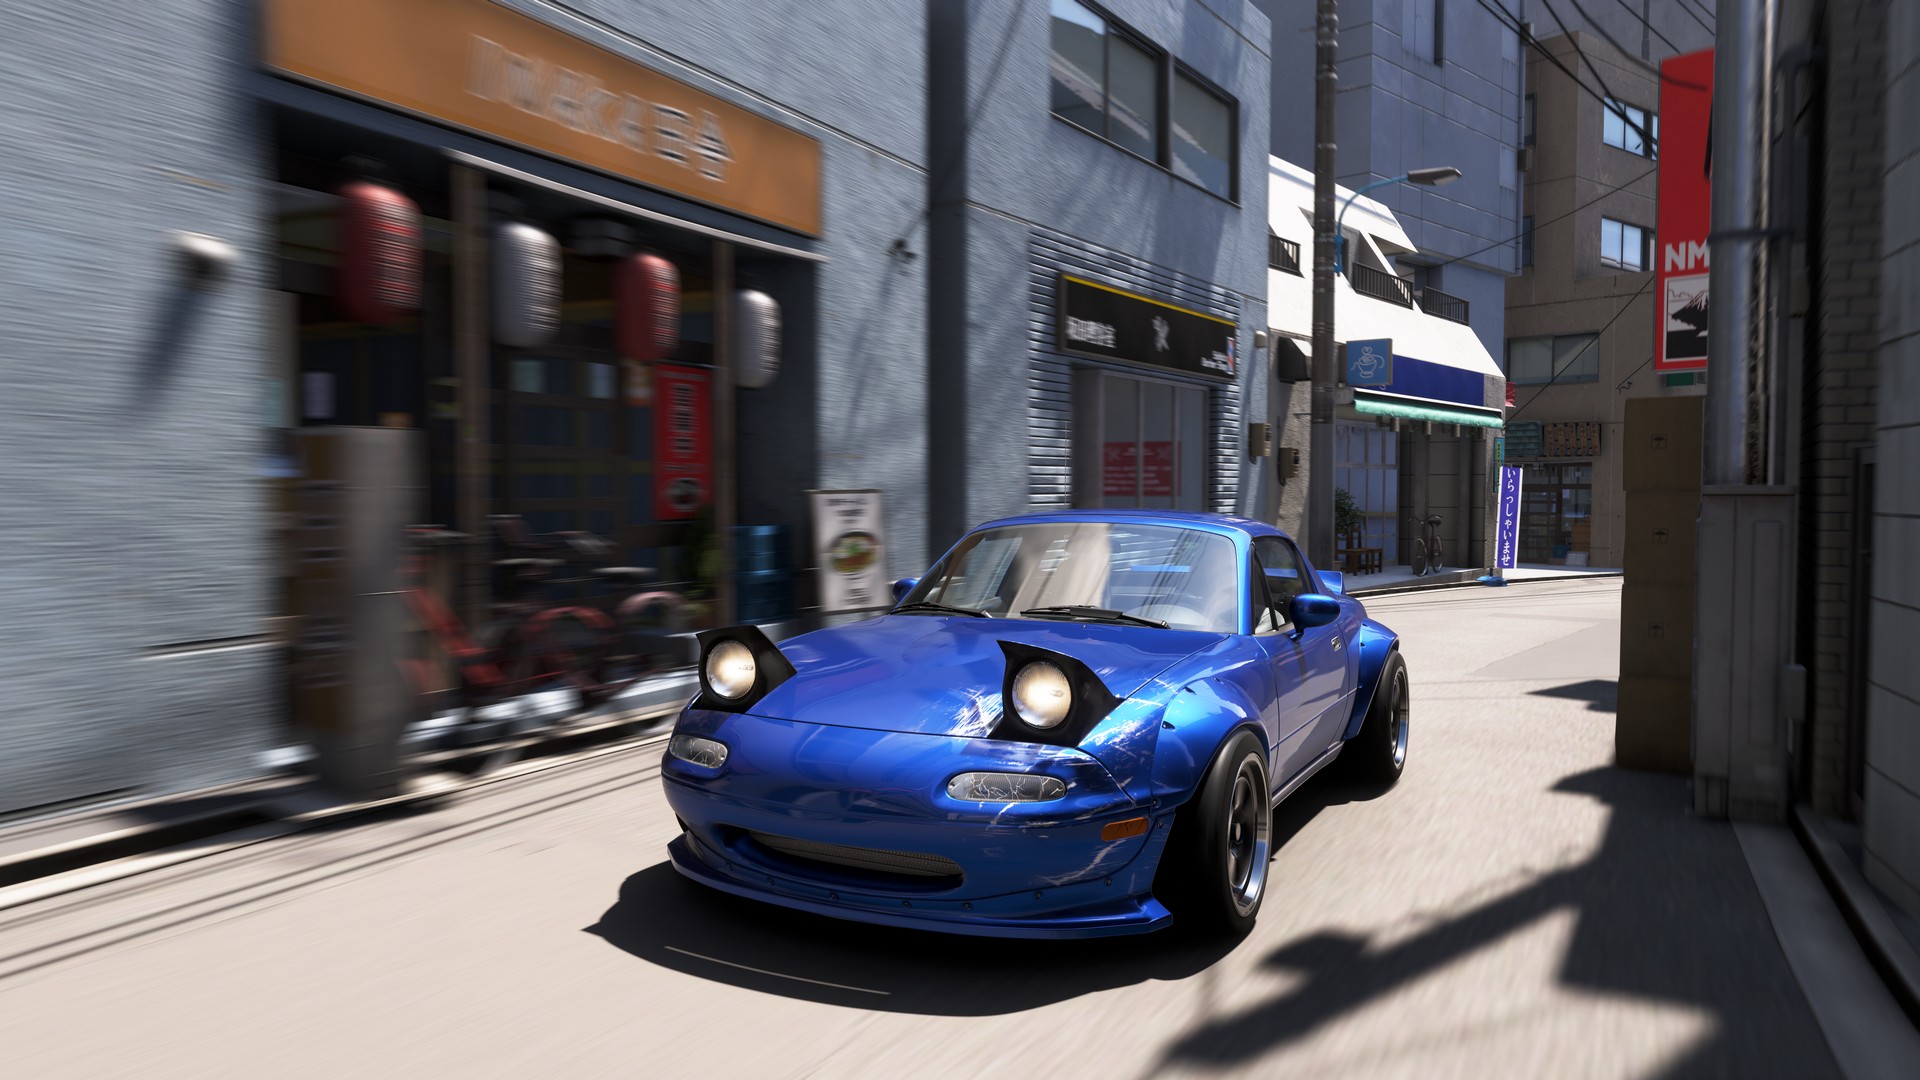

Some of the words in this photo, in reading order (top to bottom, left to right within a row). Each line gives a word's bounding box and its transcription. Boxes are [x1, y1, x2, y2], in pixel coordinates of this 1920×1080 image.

[1501, 468, 1515, 566] いらっしゃいませ
